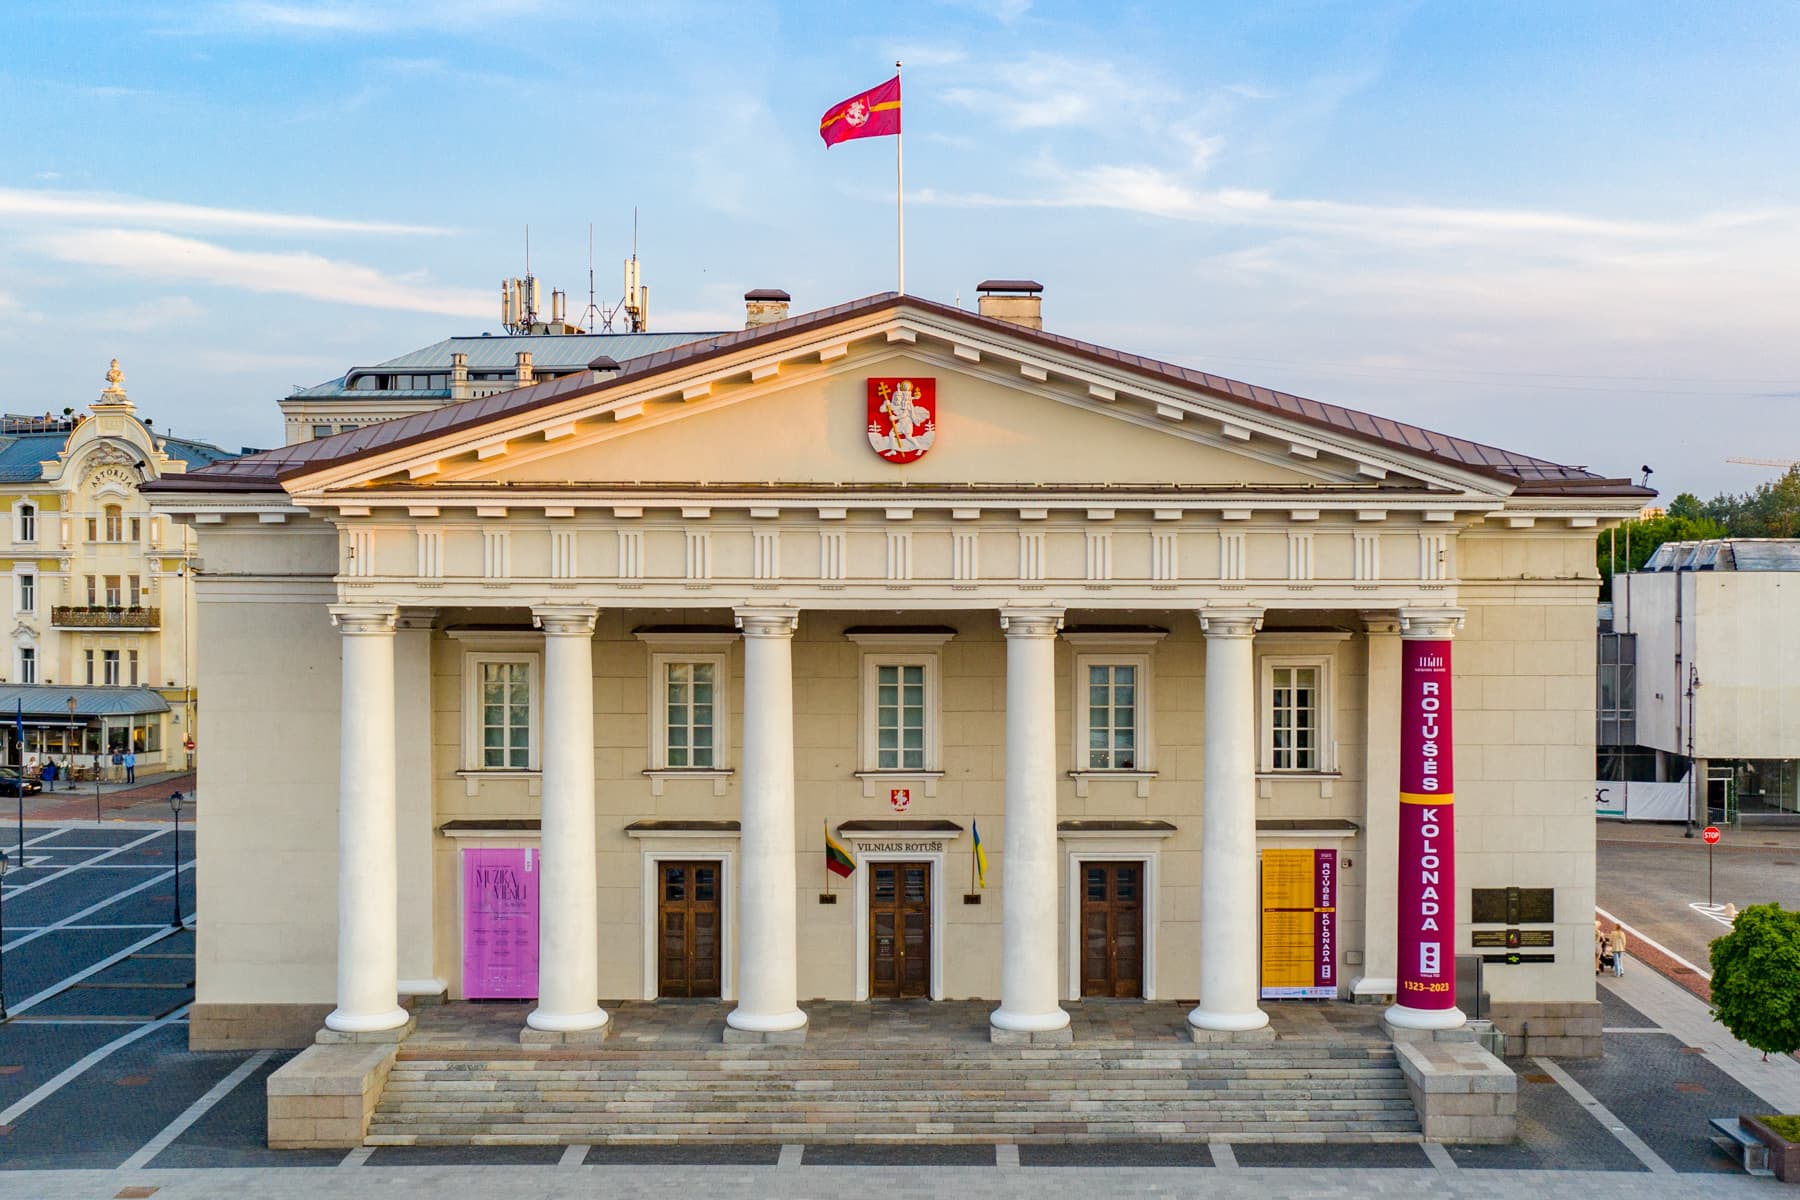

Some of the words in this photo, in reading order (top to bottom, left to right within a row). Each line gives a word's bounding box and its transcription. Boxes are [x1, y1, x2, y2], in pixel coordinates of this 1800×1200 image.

[91, 468, 132, 488] ASTORIJA
[1421, 682, 1440, 791] ROTUŠĖS
[857, 843, 903, 852] VILNIAUS
[905, 841, 943, 852] ROTUŠĖ
[1421, 809, 1439, 931] KOLONADA
[1322, 913, 1330, 962] KOLONADA
